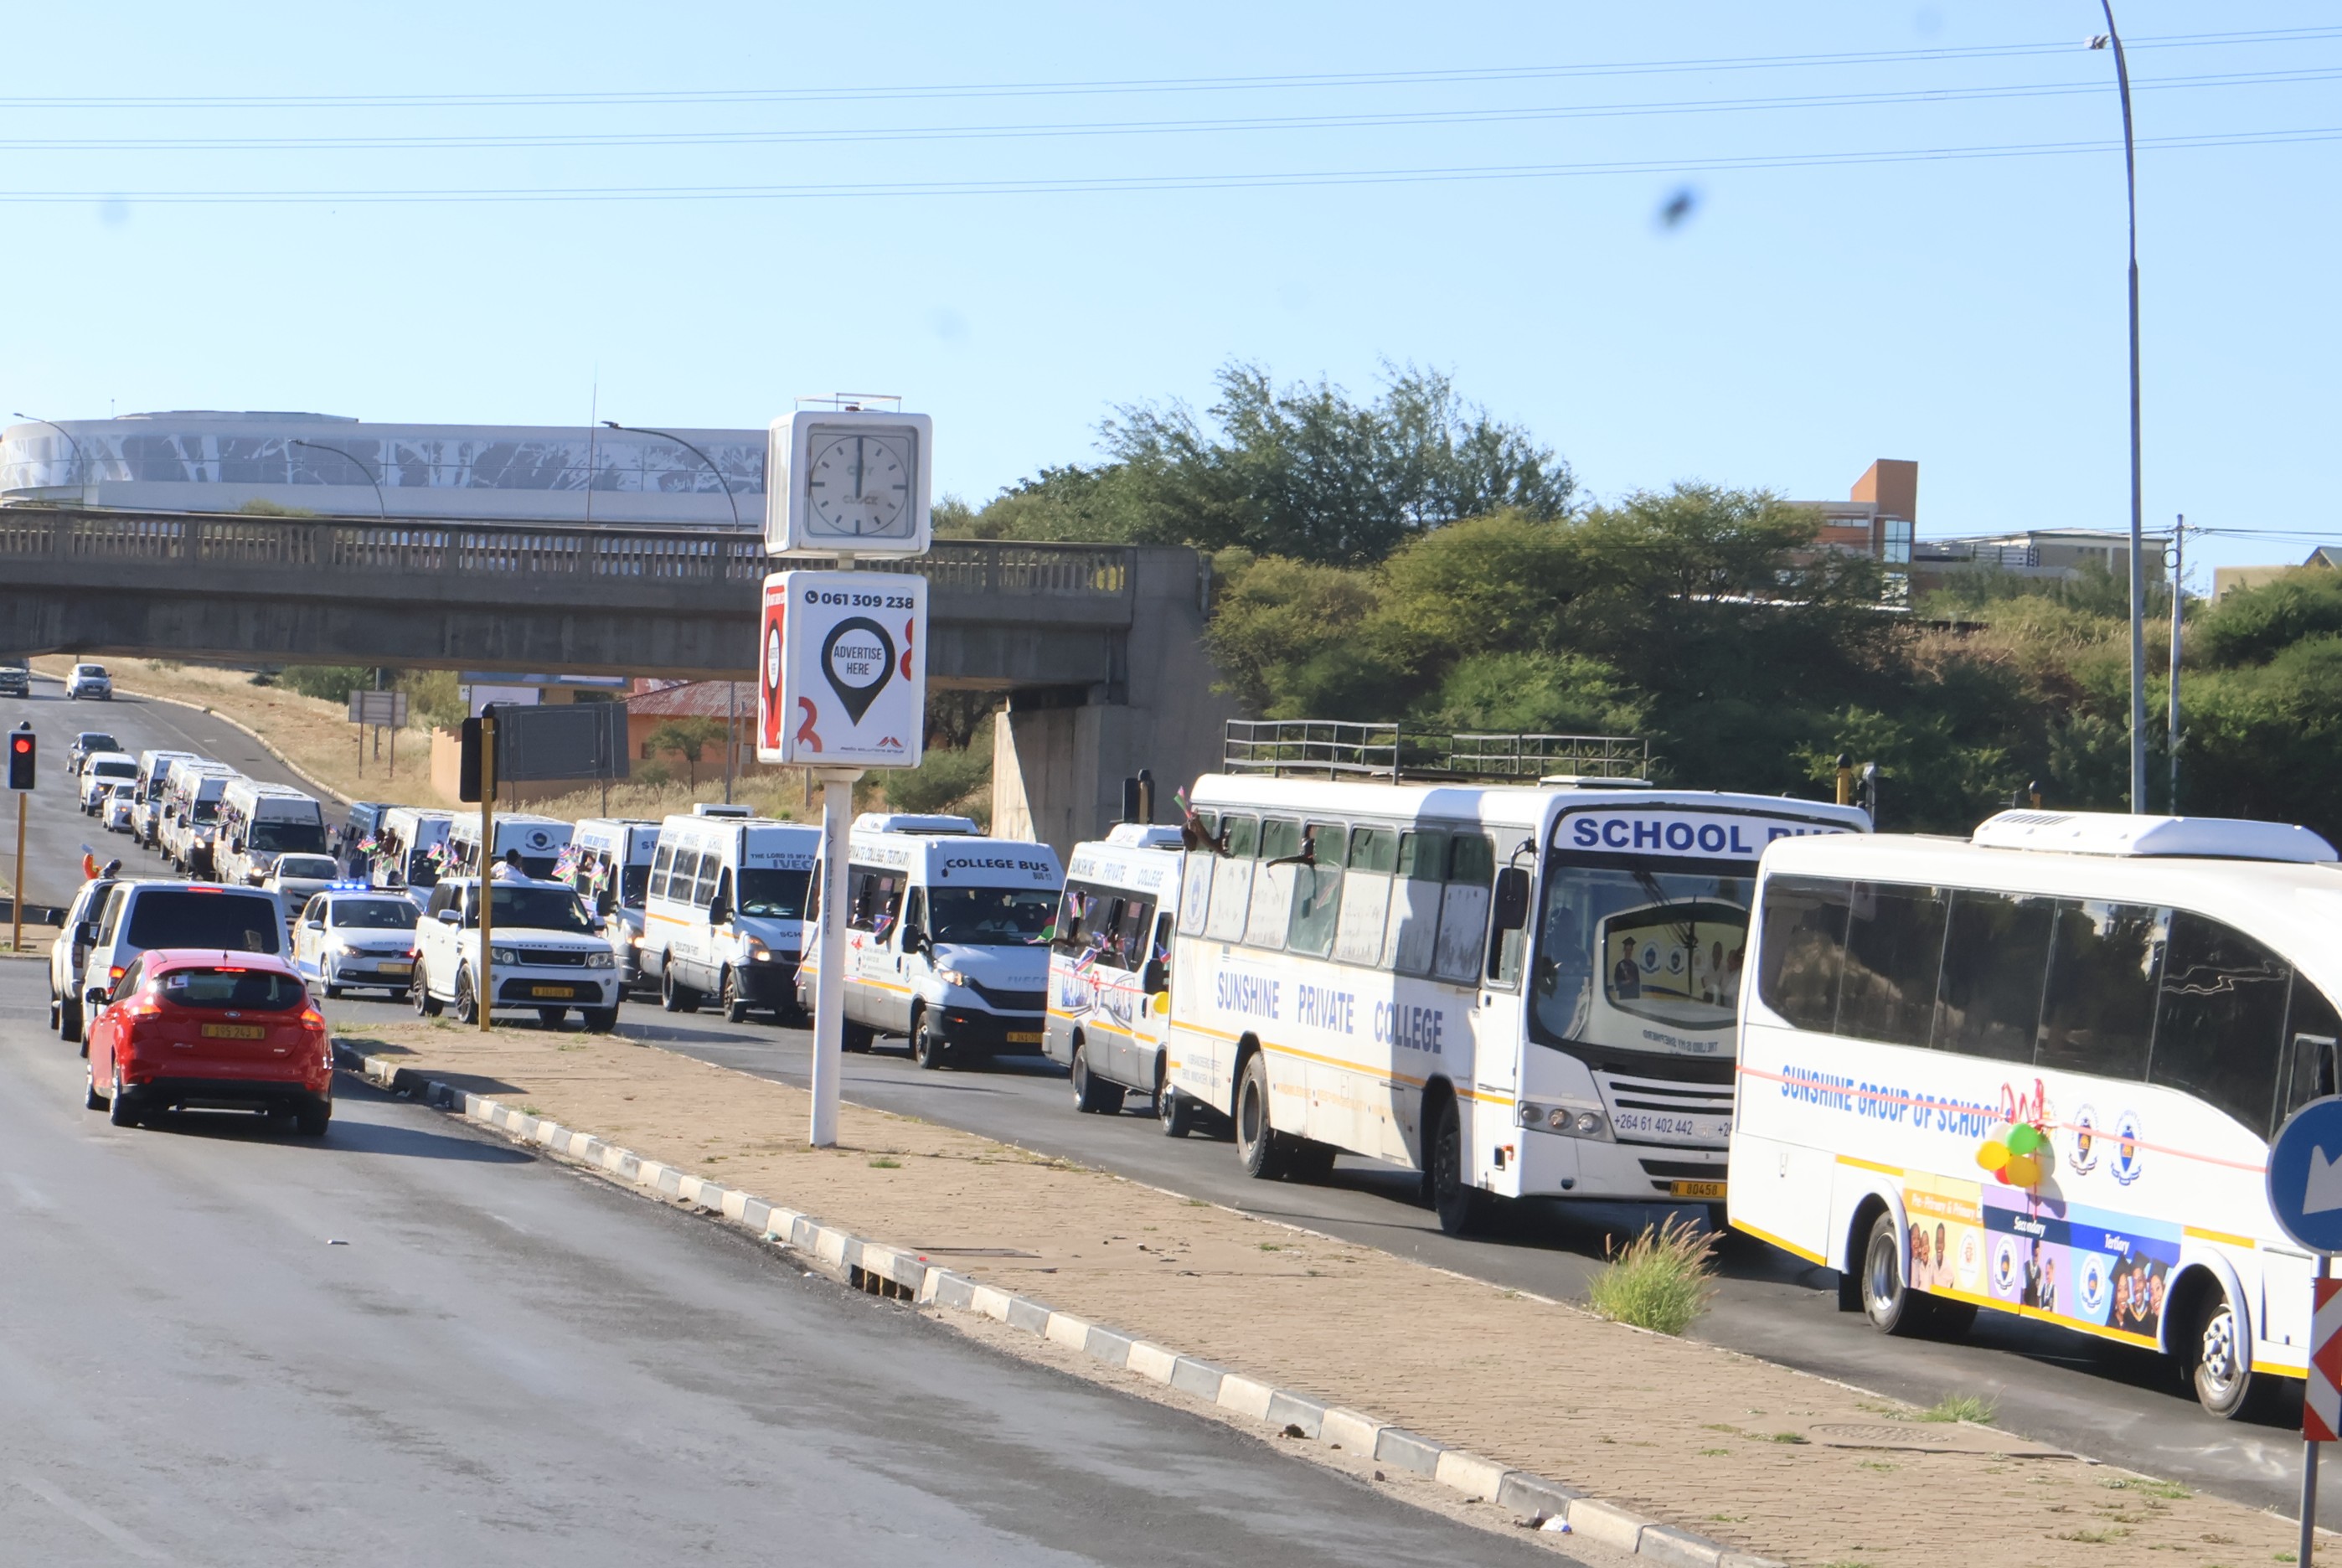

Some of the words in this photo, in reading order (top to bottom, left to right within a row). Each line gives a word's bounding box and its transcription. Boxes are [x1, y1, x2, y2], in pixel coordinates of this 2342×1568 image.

[821, 592, 849, 606] 061
[852, 594, 883, 607] 309
[886, 596, 914, 610] 238
[833, 646, 883, 660] ADVERTISE
[846, 663, 869, 675] HERE
[1573, 818, 1753, 854] SCHOOL
[772, 859, 813, 869] IVEC
[947, 859, 1014, 869] COLLEGE
[1019, 860, 1050, 873] BUS
[1070, 857, 1096, 877] SUNSHINE
[1102, 862, 1127, 883] PRIVATE
[1137, 868, 1164, 888] COLLEGE
[172, 977, 184, 986] L
[1217, 971, 1280, 1019] SUNSHINE
[1298, 983, 1354, 1034] PRIVATE
[1375, 1000, 1443, 1055] COLLEGE
[1782, 1065, 1854, 1112] SUNSHINE
[1858, 1082, 1910, 1122] GROUP
[1913, 1093, 1935, 1129] OF
[1615, 1114, 1638, 1129] +264
[1641, 1117, 1652, 1131] 61
[1655, 1117, 1673, 1133] 402
[1675, 1119, 1693, 1136] 442
[1672, 1184, 1679, 1194] N
[1687, 1184, 1718, 1195] 80458
[1953, 1201, 1975, 1222] Primary
[2104, 1233, 2130, 1255] Tertiary
